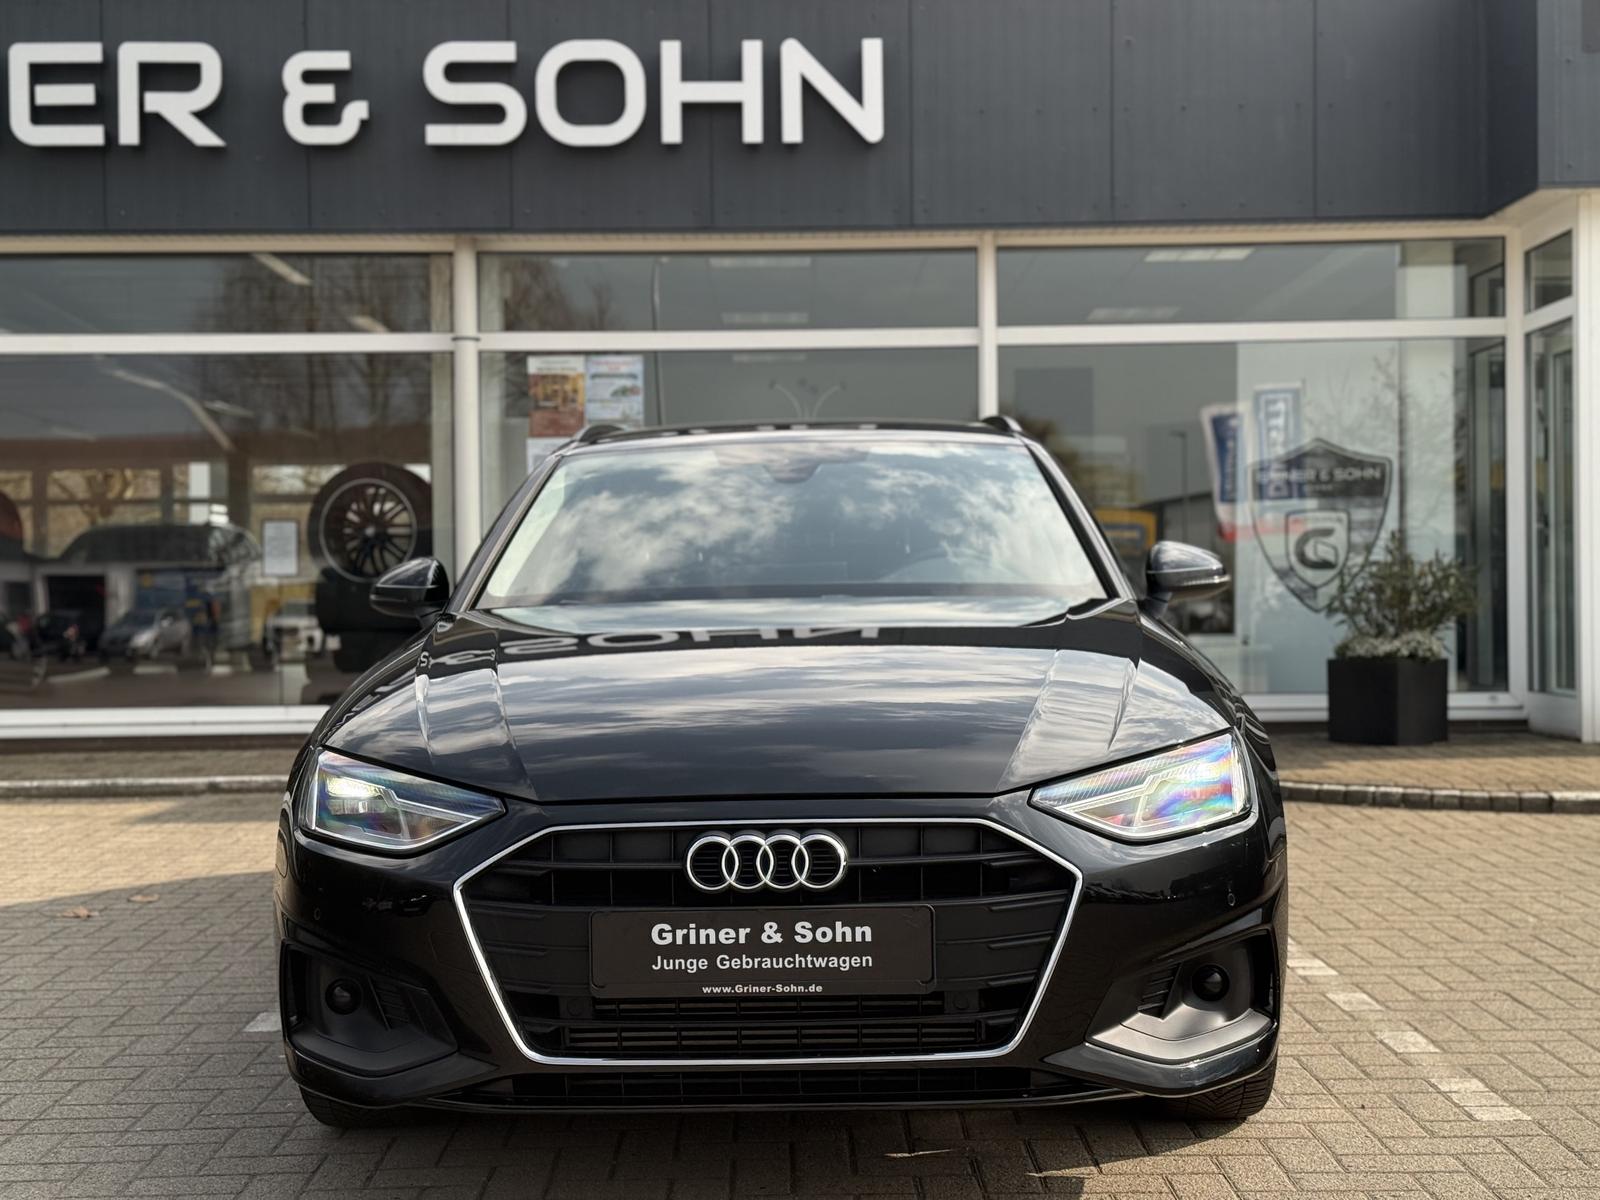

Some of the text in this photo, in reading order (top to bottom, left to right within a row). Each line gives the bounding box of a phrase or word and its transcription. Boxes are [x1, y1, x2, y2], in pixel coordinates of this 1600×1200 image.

[8, 37, 885, 147] ER & SOHN
[651, 920, 873, 946] Griner & Sohn
[651, 952, 874, 974] Junge Gebrauchtwagen
[701, 983, 824, 995] www.Griner-Sohn.de
